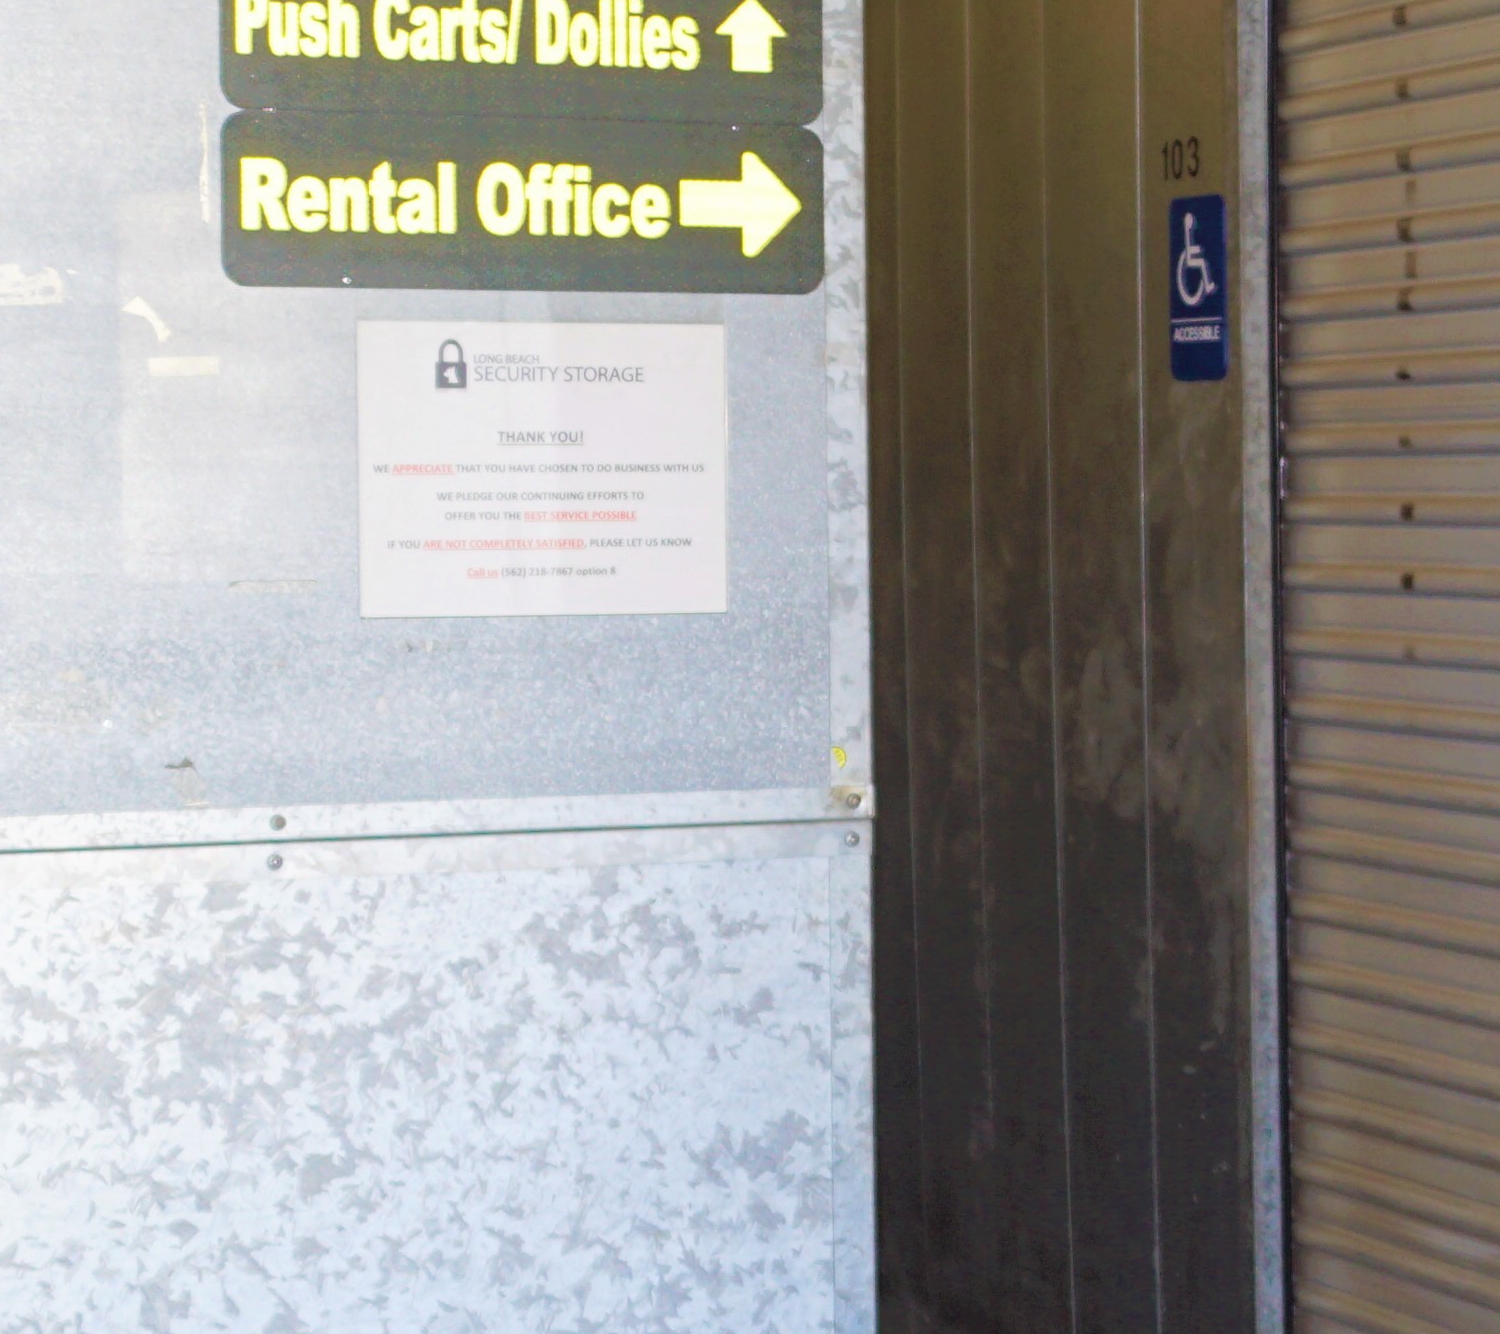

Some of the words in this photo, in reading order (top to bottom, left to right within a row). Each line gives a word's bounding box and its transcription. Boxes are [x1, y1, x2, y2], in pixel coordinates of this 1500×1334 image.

[1161, 136, 1200, 181] 103
[239, 156, 458, 234] Rental
[476, 161, 672, 238] Office
[1173, 324, 1221, 342] ACCESSIBLE
[473, 354, 503, 364] LONG
[505, 354, 540, 364] BEACH
[473, 366, 559, 382] SECURITY
[564, 367, 645, 383] STORAGE
[497, 430, 545, 443] THANK
[549, 430, 584, 443] YOU!
[373, 464, 390, 473] WE
[392, 463, 454, 474] APPRECIATE
[456, 464, 481, 473] THAT
[484, 464, 506, 473] YOU
[508, 464, 535, 473] HAVE
[538, 464, 578, 473] CHOSEN
[581, 464, 594, 473] TO
[597, 464, 611, 473] DO
[614, 464, 660, 473] BUSINESS
[663, 464, 689, 473] WITH
[692, 464, 705, 473] US
[436, 492, 453, 501] WE
[456, 492, 493, 501] PLEDGE
[496, 492, 518, 501] OUR
[520, 491, 584, 501] CONTINUING
[587, 491, 628, 500] EFFORTS
[631, 491, 644, 500] TO
[444, 511, 476, 521] OFFER
[479, 511, 500, 521] YOU
[503, 511, 522, 521] THE
[524, 511, 548, 520] BEST
[551, 511, 589, 520] SERVICE
[592, 510, 637, 520] POSSIBLE
[387, 540, 396, 549] IF
[398, 540, 421, 549] YOU
[423, 539, 442, 549] ARE
[446, 539, 467, 549] NOT
[469, 539, 533, 549] COMPLETELY
[589, 538, 624, 547] PLEASE
[626, 538, 642, 547] LET
[645, 538, 658, 547] US
[660, 537, 693, 547] KNOW
[467, 568, 485, 577] Call
[487, 569, 499, 577] us
[501, 567, 527, 578] (562)
[576, 566, 608, 577] option
[610, 567, 616, 575] 8
